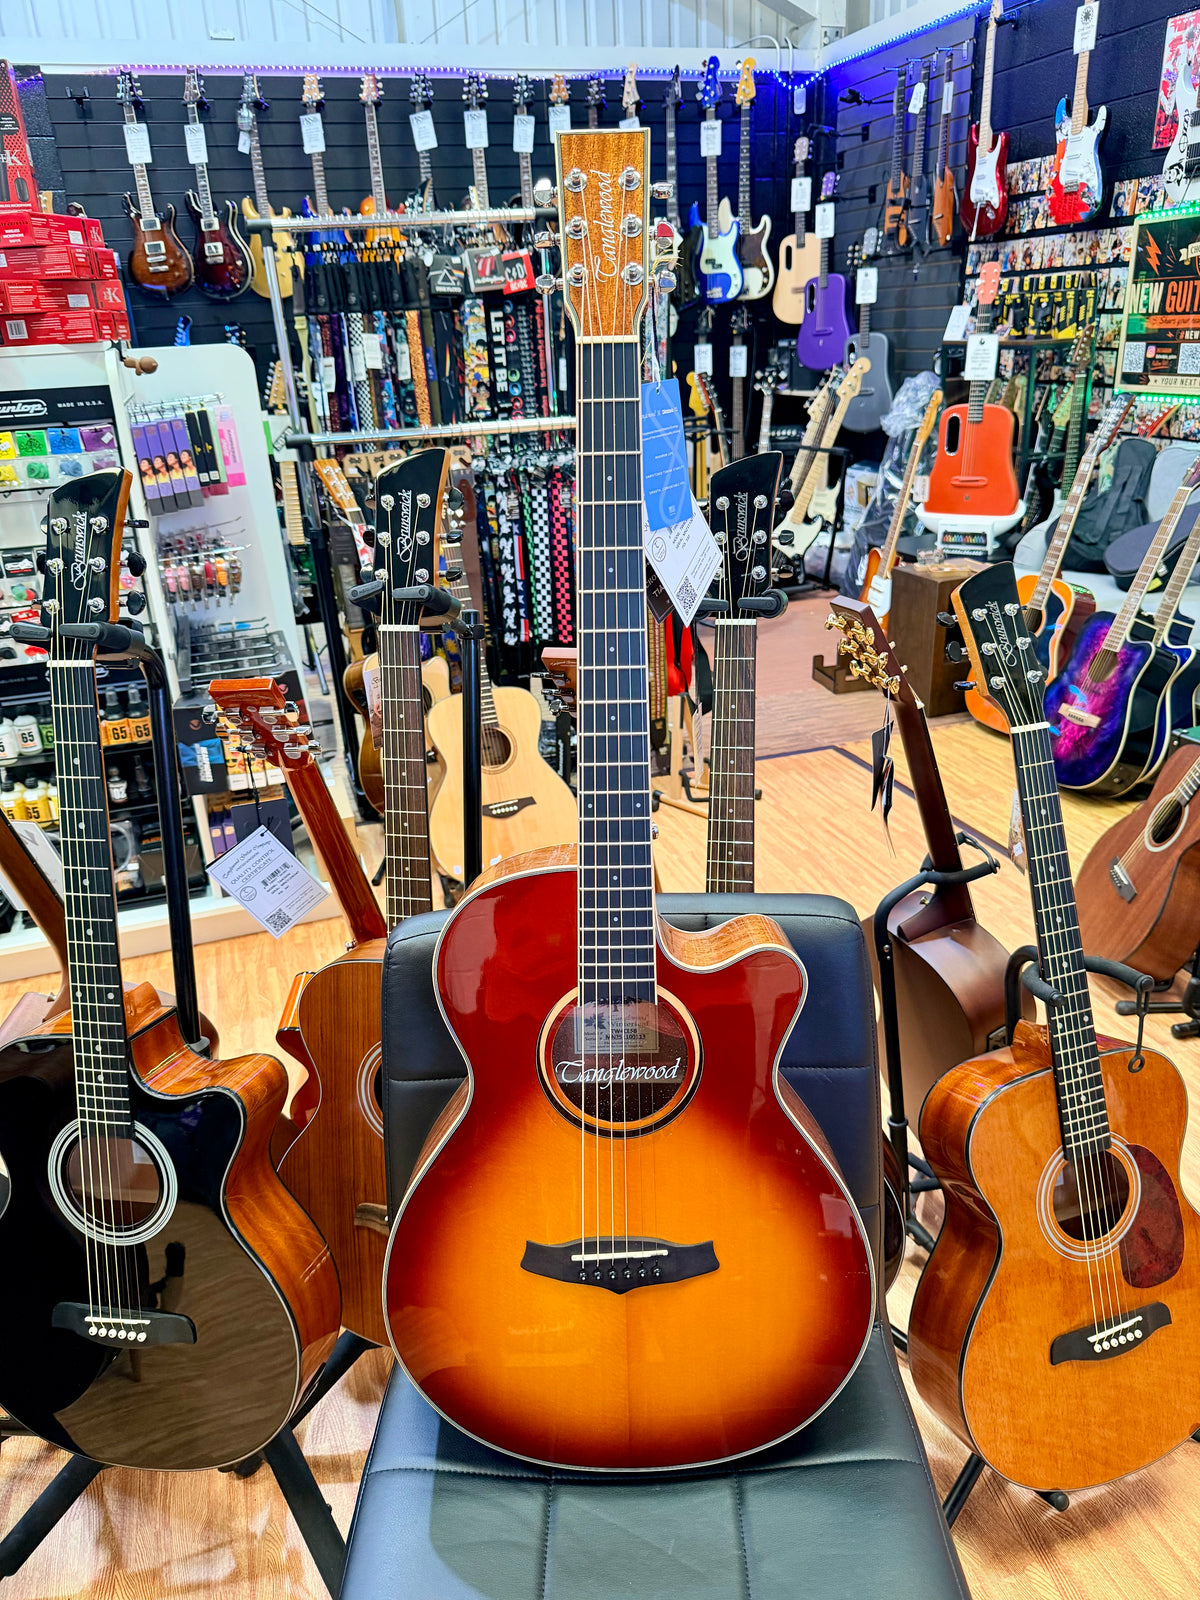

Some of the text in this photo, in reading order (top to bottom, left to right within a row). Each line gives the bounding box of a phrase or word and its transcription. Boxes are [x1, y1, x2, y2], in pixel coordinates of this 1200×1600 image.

[589, 169, 624, 283] Tanglewood
[1129, 281, 1165, 314] NEW
[490, 310, 509, 393] LET IT BE
[1161, 377, 1197, 386] YOUR NEXT
[0, 402, 44, 414] unlop
[397, 488, 413, 563] Brunswick
[732, 491, 749, 562] Brunswick
[70, 510, 88, 591] Brunswick
[984, 600, 1018, 667] Brunswick
[20, 731, 35, 744] 65
[45, 730, 54, 743] 6
[112, 727, 127, 741] 65
[135, 725, 151, 738] 65
[25, 806, 41, 820] 65
[230, 848, 276, 886] QUALITY CONTROL
[241, 856, 273, 884] CERTIFICATE
[555, 1057, 682, 1090] Tanglewood
